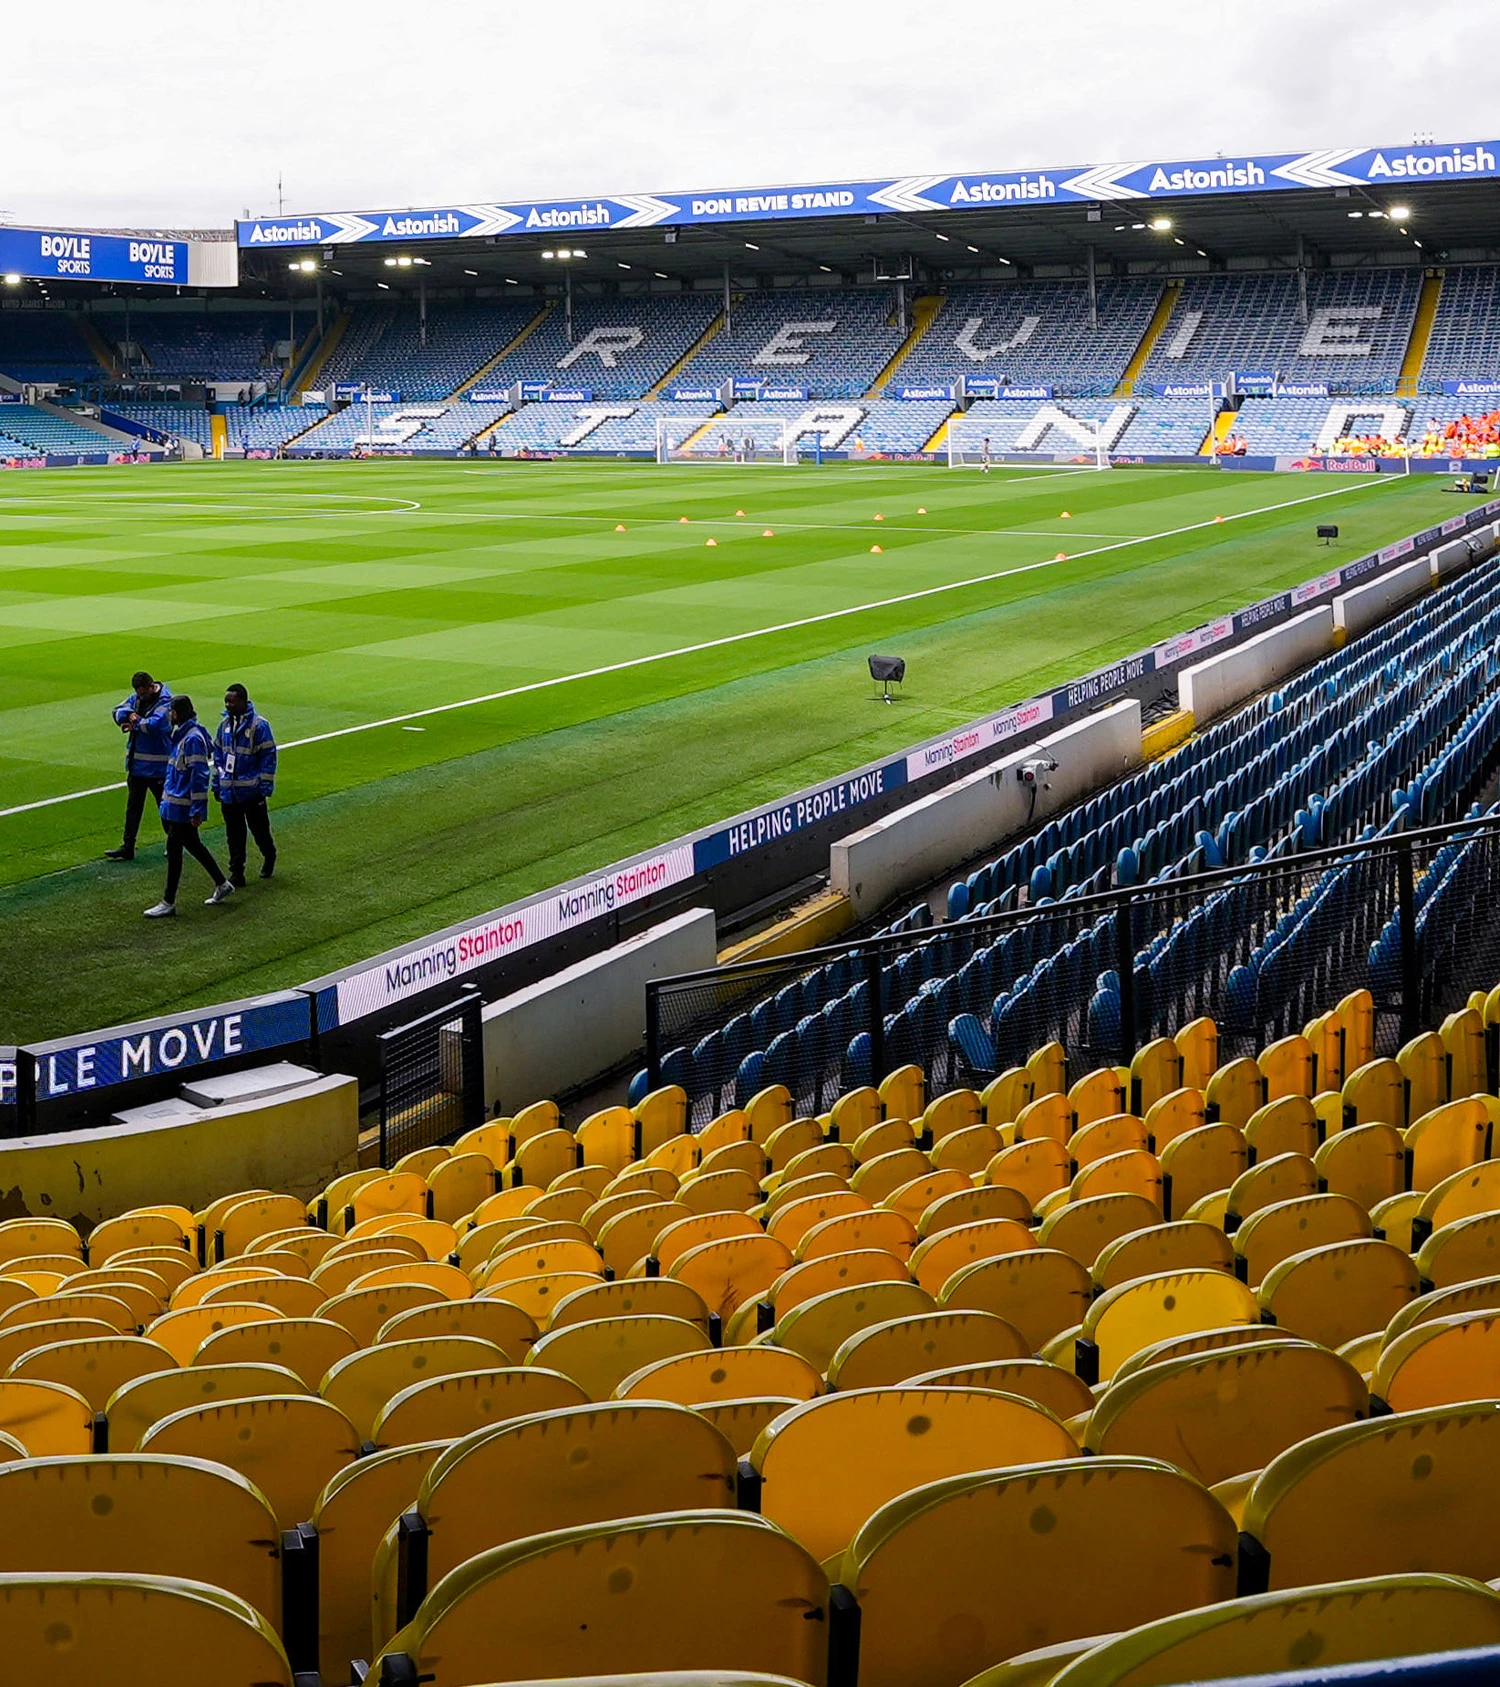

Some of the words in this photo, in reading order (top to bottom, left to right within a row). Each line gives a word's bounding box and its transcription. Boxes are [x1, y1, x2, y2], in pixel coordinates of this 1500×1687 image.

[1367, 146, 1496, 178] Astonish
[1149, 162, 1265, 191] Astonish
[950, 175, 1056, 203] Astonish
[692, 198, 733, 216] DON
[736, 196, 789, 213] REVIE
[792, 191, 854, 209] STAND
[382, 213, 459, 237] Astonish
[526, 204, 609, 228] Astonish
[250, 222, 321, 244] Astonish
[41, 235, 90, 259] BOYLE
[129, 242, 174, 264] BOYLE
[57, 258, 90, 275] SPORTS
[144, 264, 174, 279] SPORTS
[1002, 387, 1047, 397] Astonish
[1238, 376, 1273, 384] Astonish
[1278, 384, 1327, 396] Astonish
[470, 391, 505, 400] Astonish
[548, 391, 584, 400] Astonish
[675, 388, 713, 399] Astonish
[763, 389, 803, 399] Astonish
[903, 387, 945, 398] Astonish
[1326, 459, 1351, 471] Red
[1352, 459, 1375, 471] Bull
[1068, 678, 1099, 707] HELPING
[1100, 666, 1125, 692] PEOPLE
[1127, 659, 1144, 680] MOVE
[992, 715, 1016, 737] Manning
[1016, 705, 1040, 726] Stainton
[924, 743, 953, 767] Manning
[953, 731, 980, 754] Stainton
[728, 806, 792, 856] HELPING
[798, 785, 845, 828] PEOPLE
[850, 769, 884, 804] MOVE
[558, 883, 614, 923] Manning
[616, 860, 666, 898] Stainton
[386, 945, 456, 993] Manning
[458, 916, 524, 964] Stainton
[122, 1014, 242, 1079] MOVE
